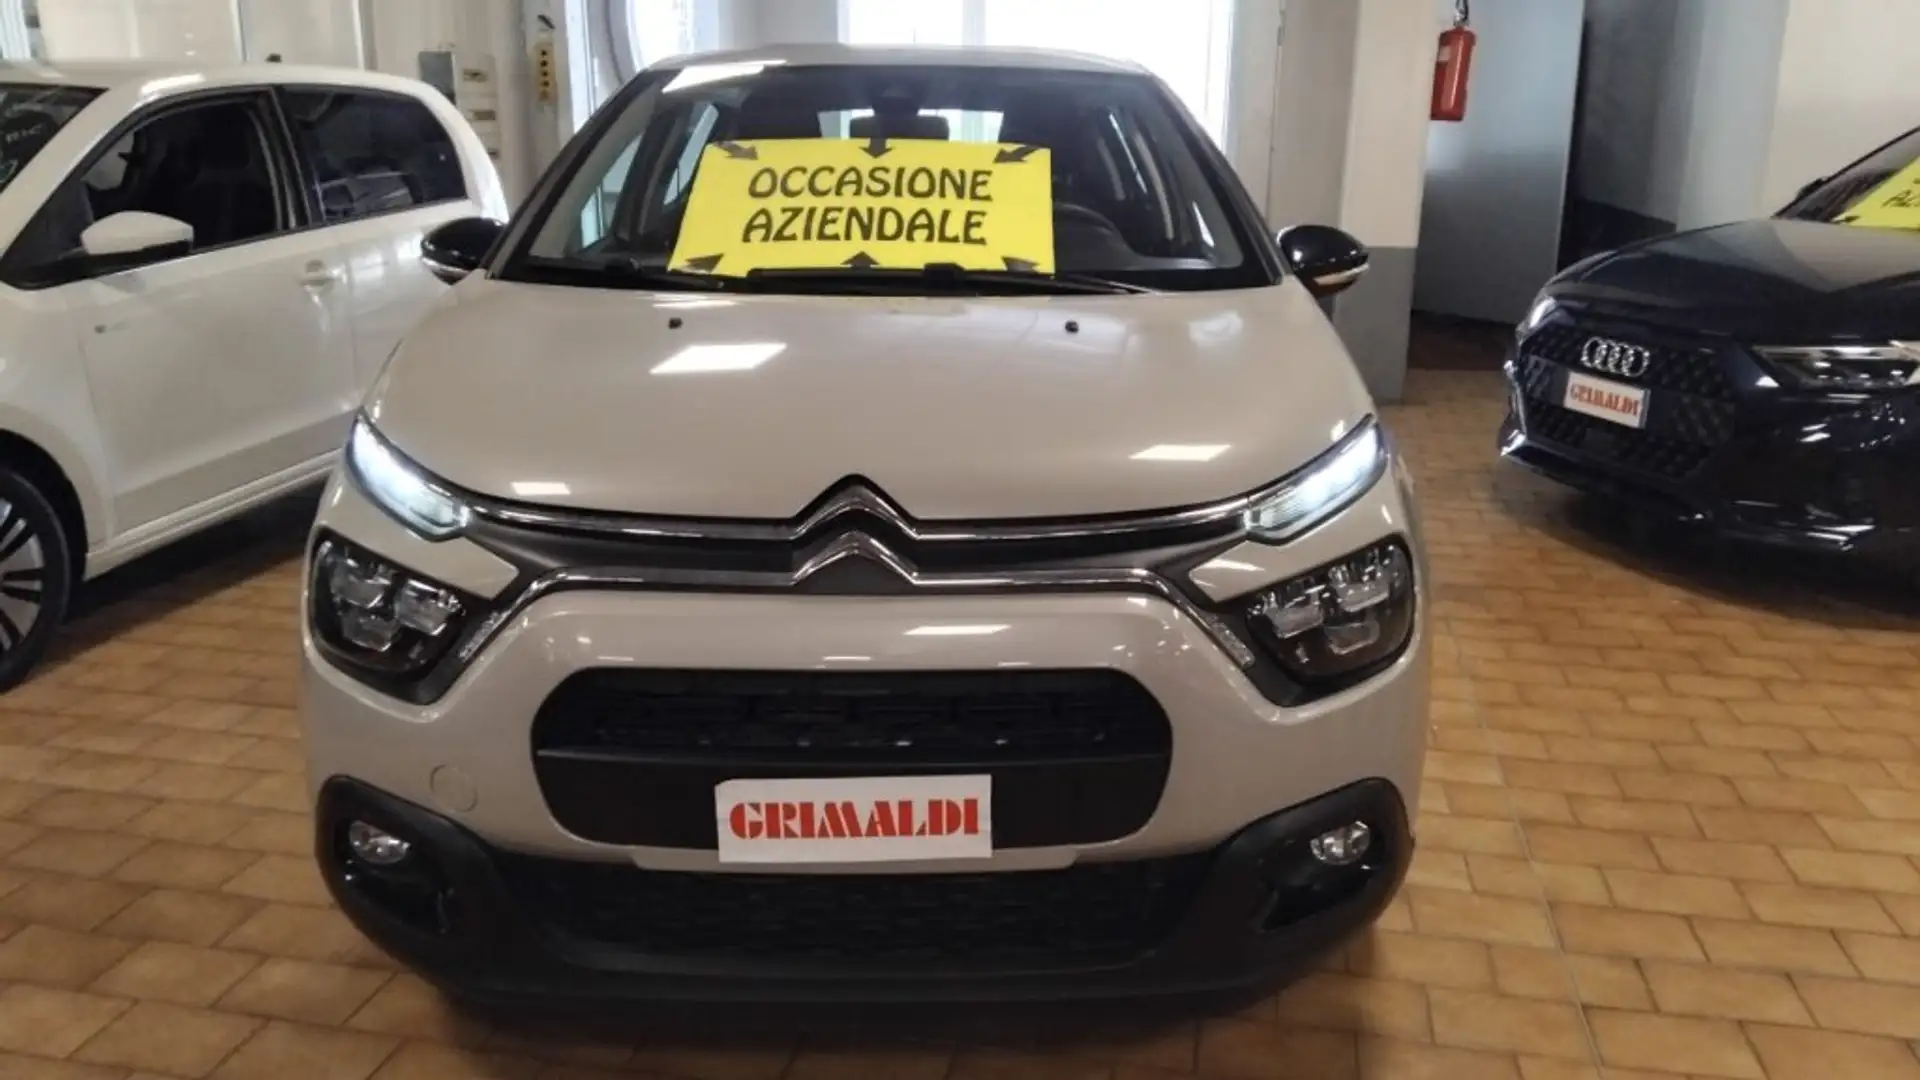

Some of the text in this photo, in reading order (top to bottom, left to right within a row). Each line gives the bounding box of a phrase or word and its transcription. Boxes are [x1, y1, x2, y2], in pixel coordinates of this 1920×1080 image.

[748, 166, 993, 201] OCCASIONE
[741, 206, 988, 246] AZIENDALE
[729, 797, 979, 840] GRIMALDI
